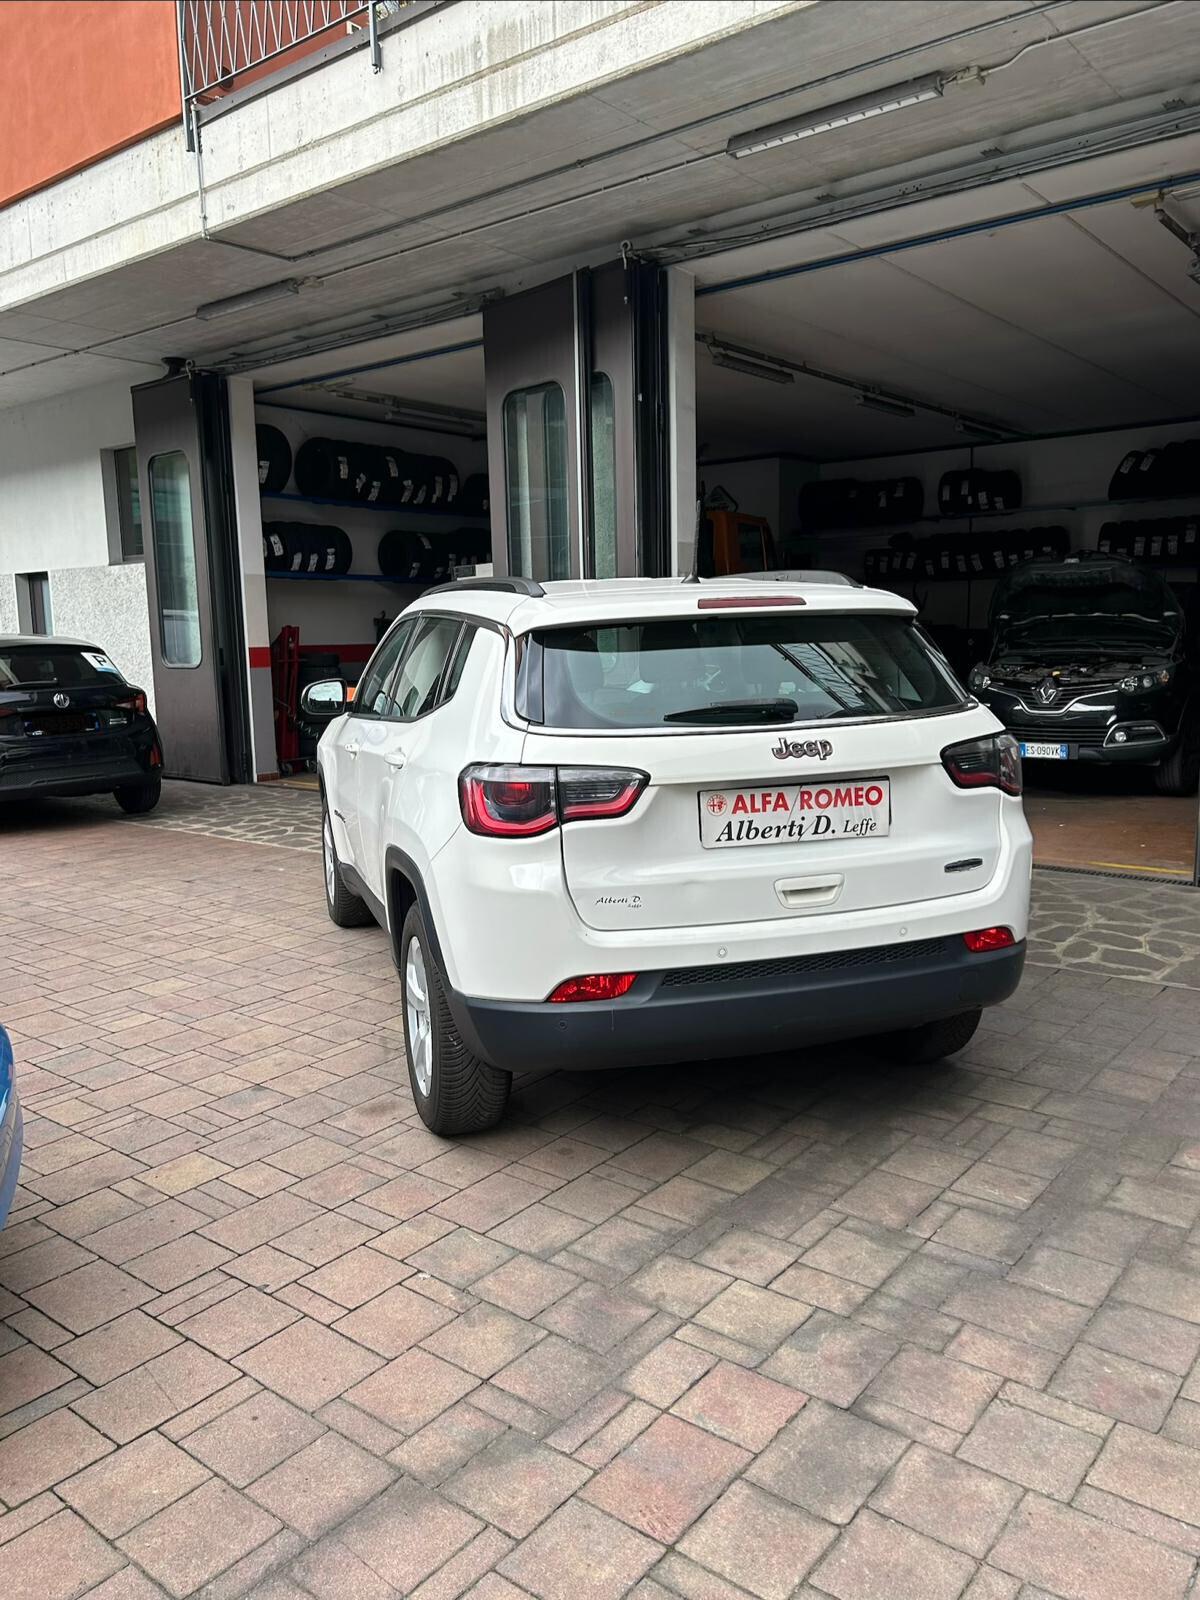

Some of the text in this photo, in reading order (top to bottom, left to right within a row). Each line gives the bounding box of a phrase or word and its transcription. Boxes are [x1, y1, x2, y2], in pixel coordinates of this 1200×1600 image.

[771, 737, 834, 760] Jeep
[731, 792, 790, 815] ALFA
[799, 785, 883, 810] ROMEO
[715, 815, 877, 842] Alberti D. Leffe
[595, 896, 628, 905] Alberti
